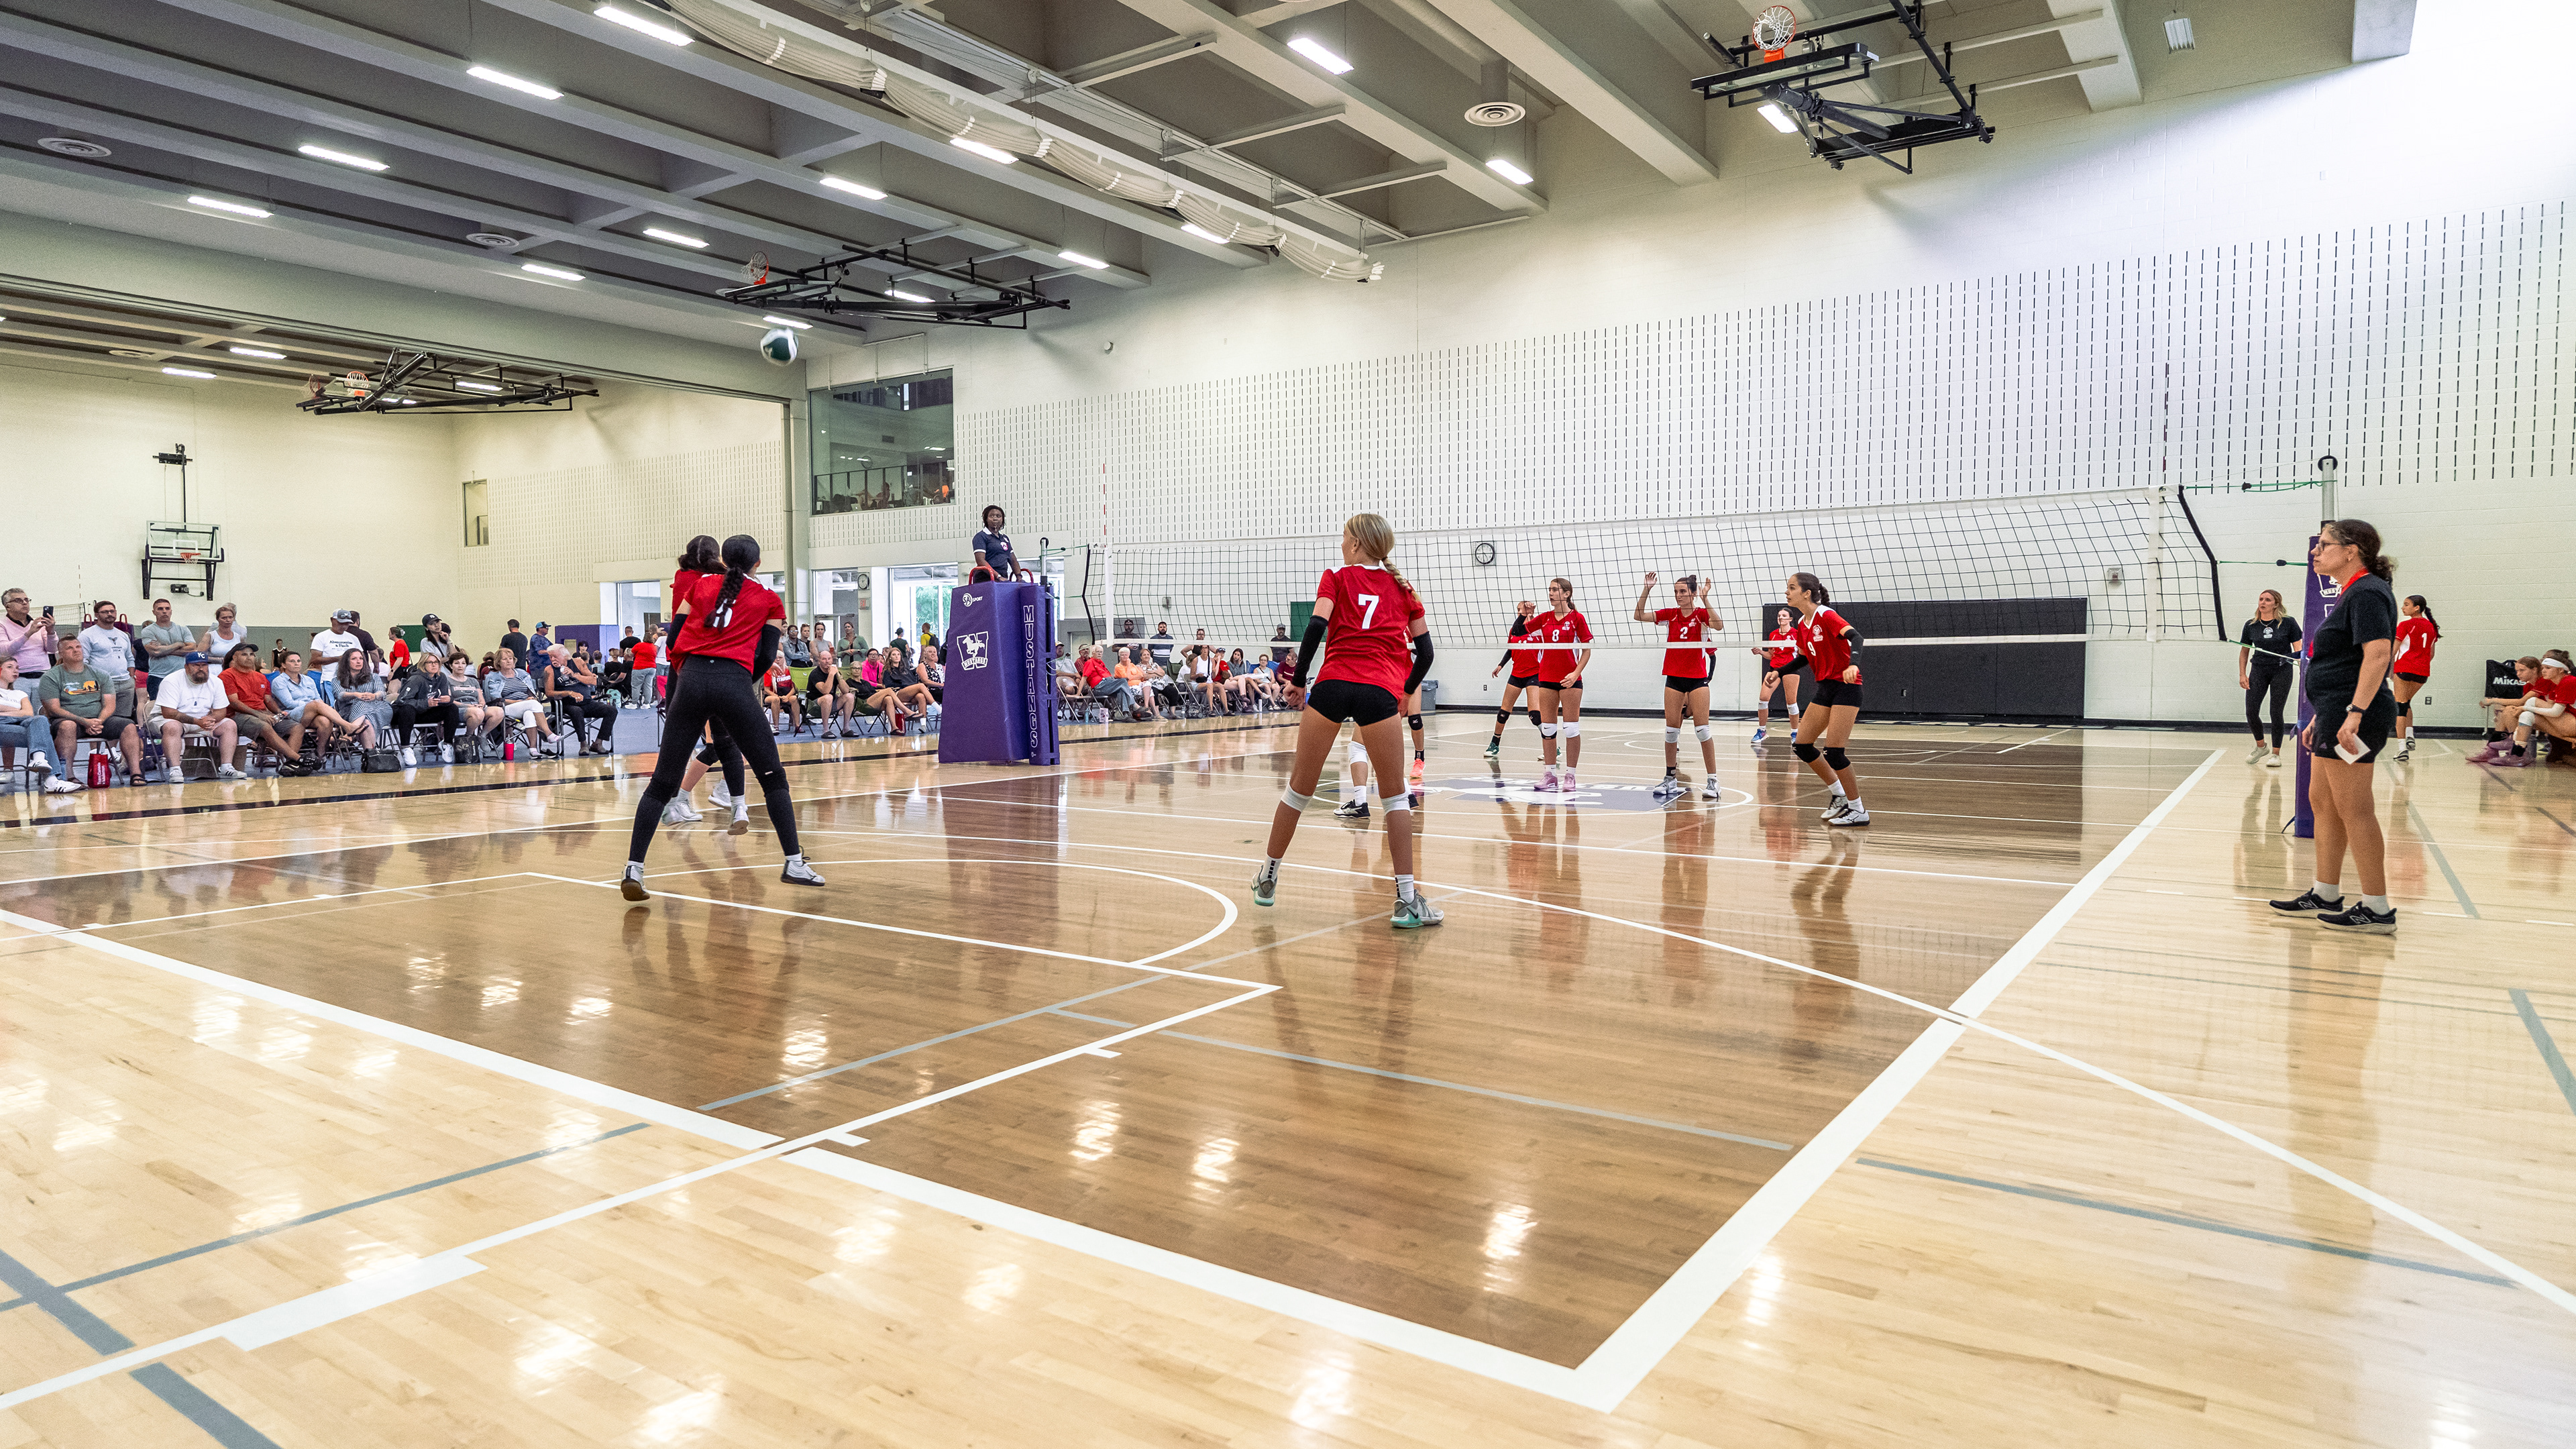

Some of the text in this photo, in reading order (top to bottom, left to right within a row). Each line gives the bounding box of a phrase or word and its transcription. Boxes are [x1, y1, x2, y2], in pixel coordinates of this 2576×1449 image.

[1358, 594, 1380, 629] 7
[1552, 629, 1559, 642] 8
[1680, 627, 1688, 639] 2
[2422, 633, 2427, 648] 1
[1807, 641, 1816, 656] 9
[1023, 605, 1038, 749] MUSTANGS
[2493, 676, 2528, 686] MIKAS
